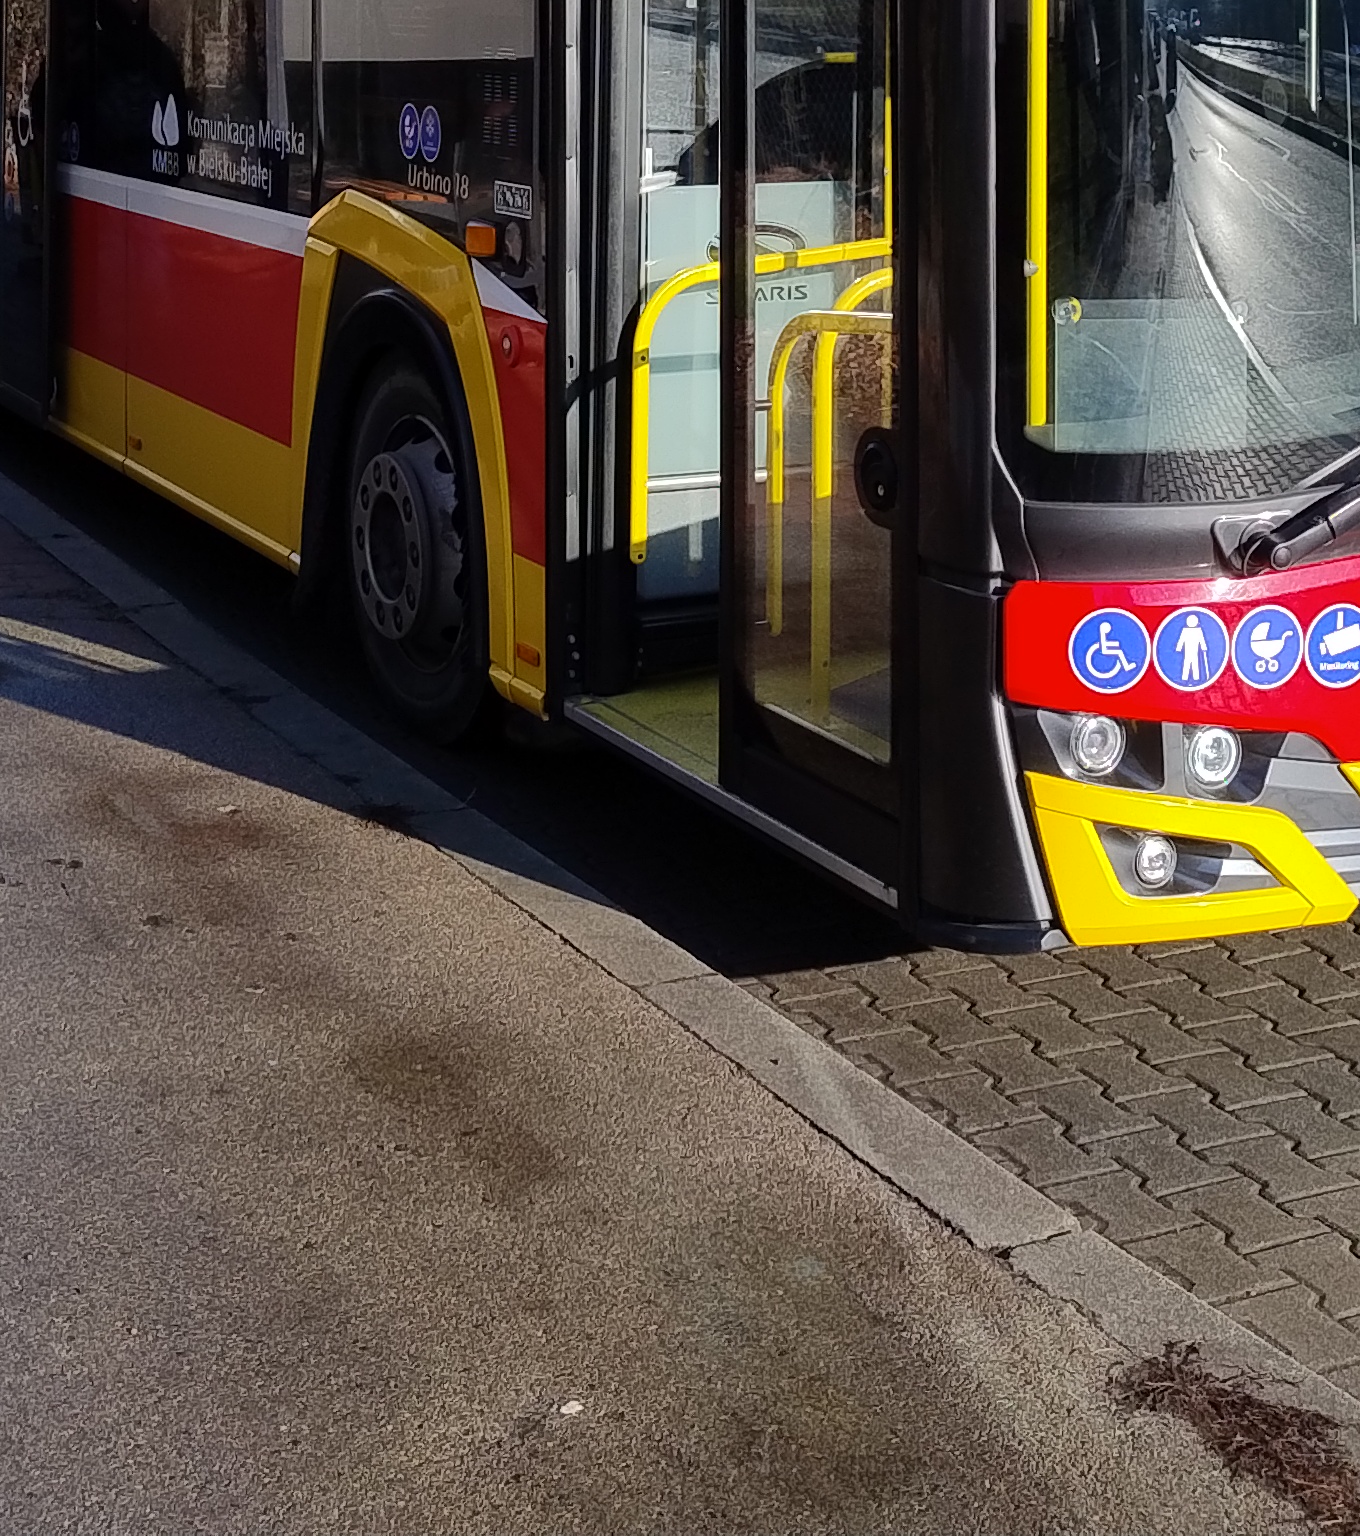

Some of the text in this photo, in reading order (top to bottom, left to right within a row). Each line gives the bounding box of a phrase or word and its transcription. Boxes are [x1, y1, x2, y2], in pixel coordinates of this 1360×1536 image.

[187, 110, 305, 160] Komunikacja Miejska
[152, 149, 179, 176] KMBB
[187, 148, 272, 198] w Bielsku-Białej
[407, 164, 470, 199] Urbino 18
